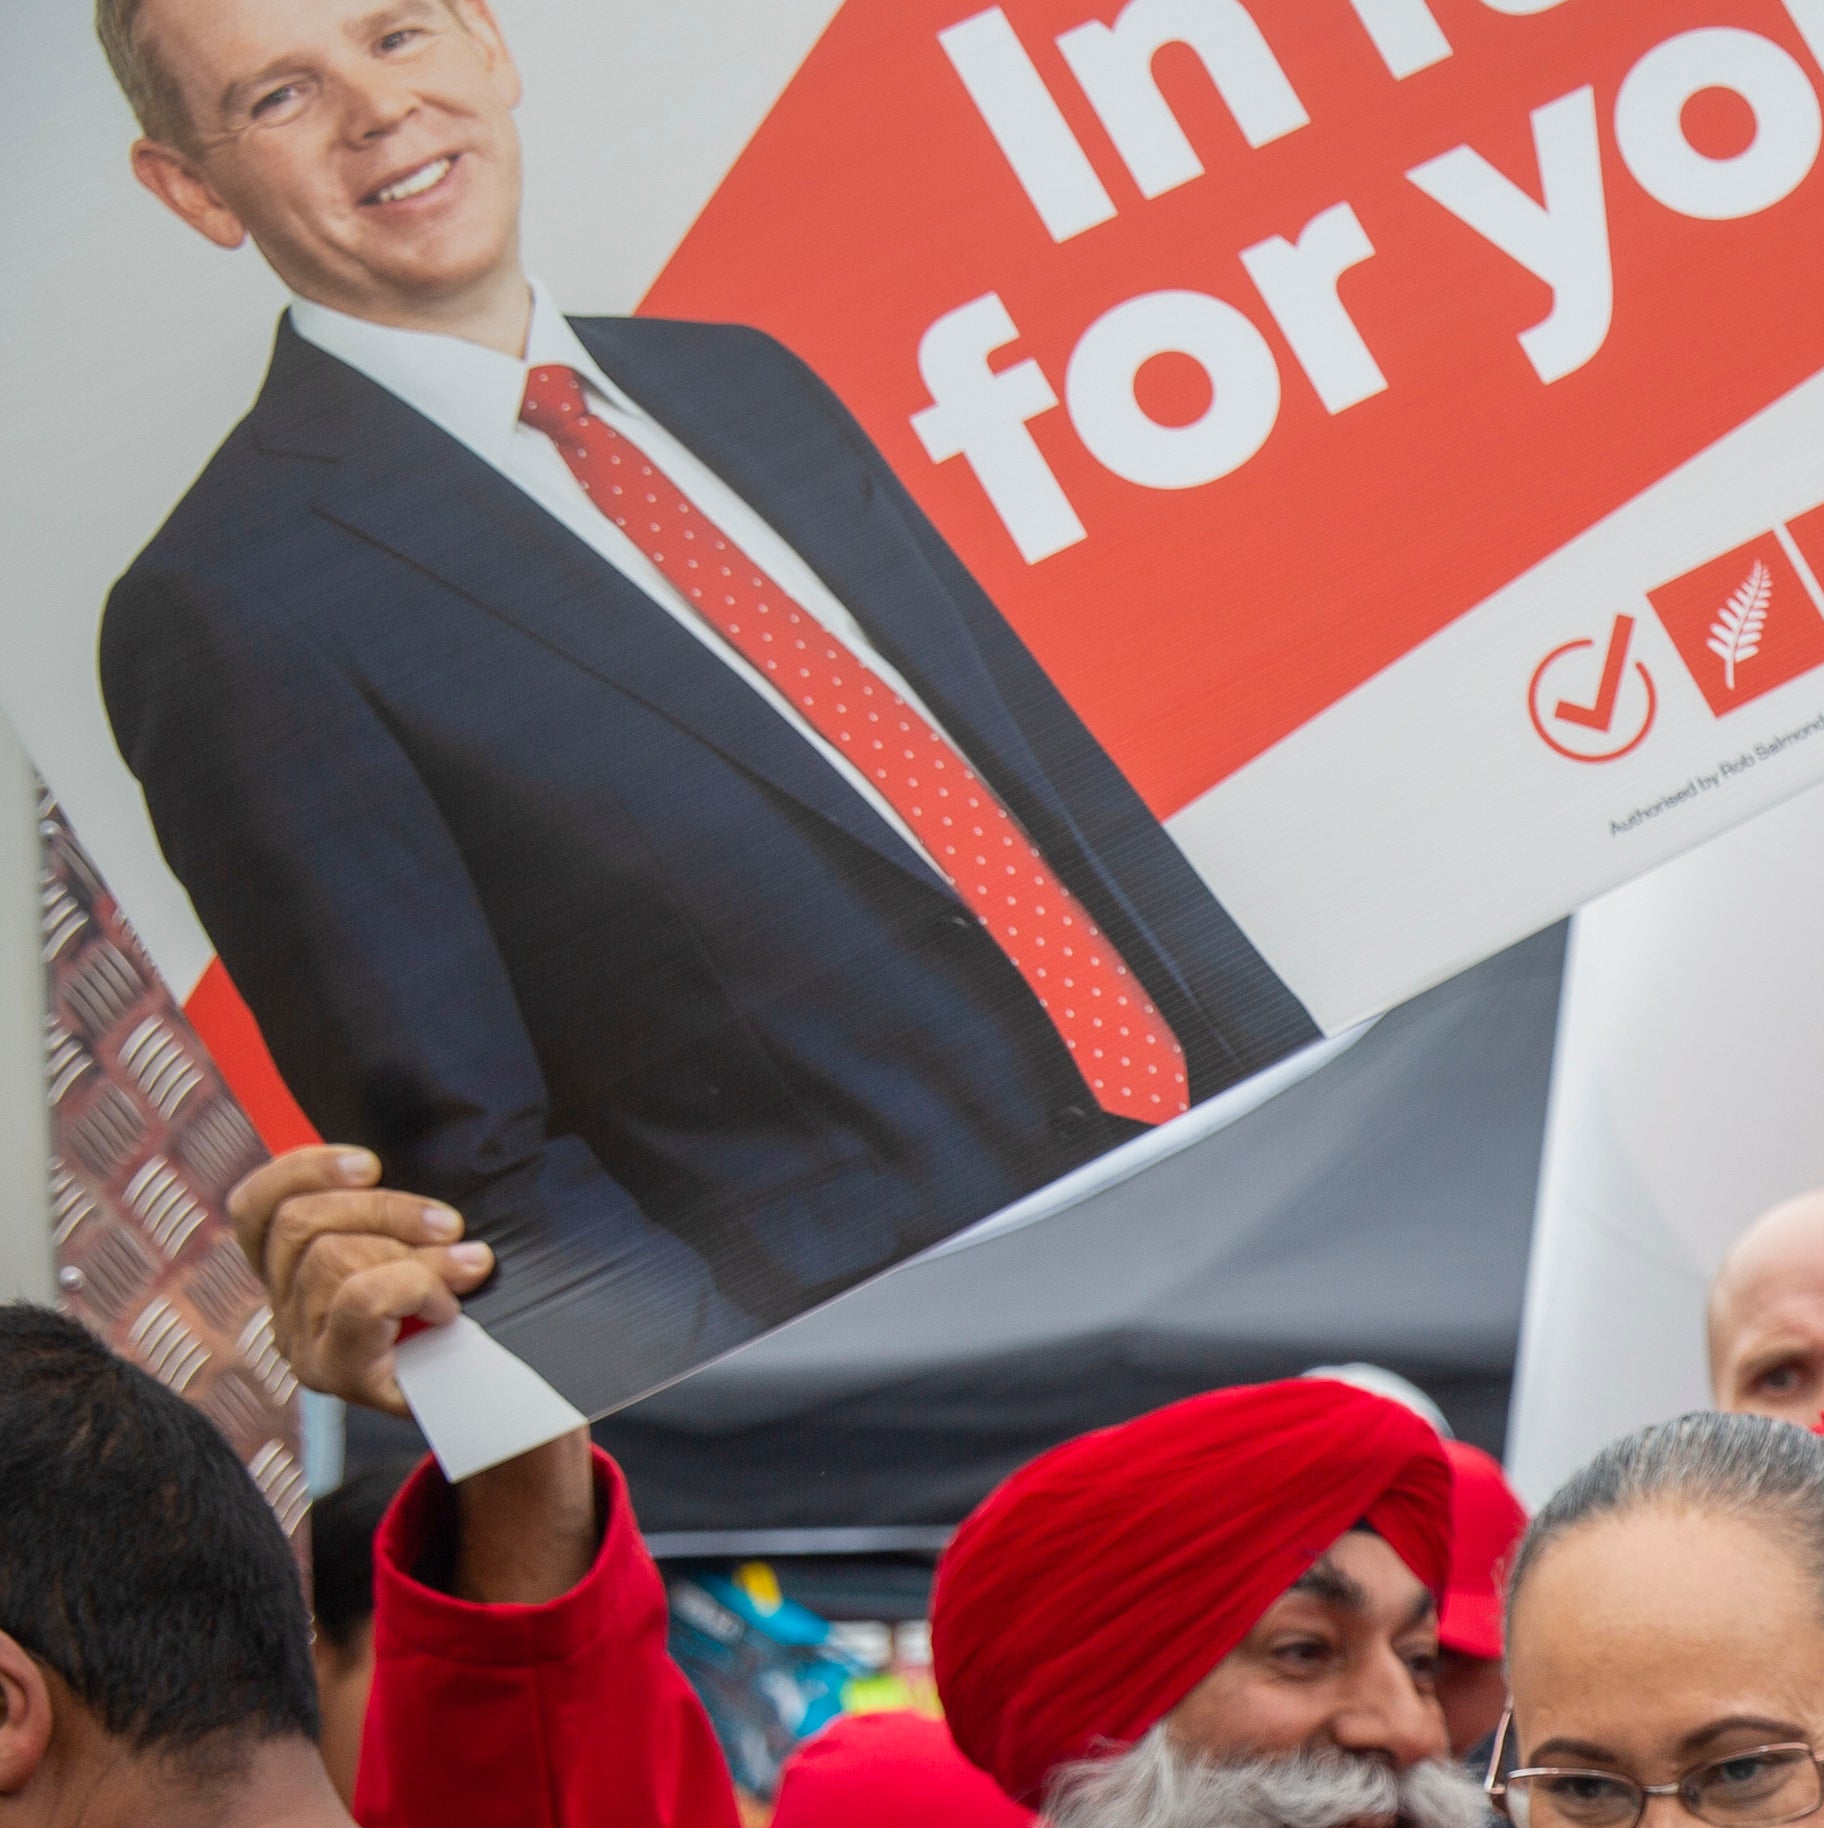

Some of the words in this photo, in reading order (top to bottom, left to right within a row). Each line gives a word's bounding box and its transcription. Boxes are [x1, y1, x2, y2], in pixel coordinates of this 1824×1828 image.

[936, 0, 1311, 244] In
[908, 200, 1389, 566] for
[1606, 779, 1698, 837] Authorised
[1695, 767, 1721, 793] by
[1718, 749, 1756, 780] Rob
